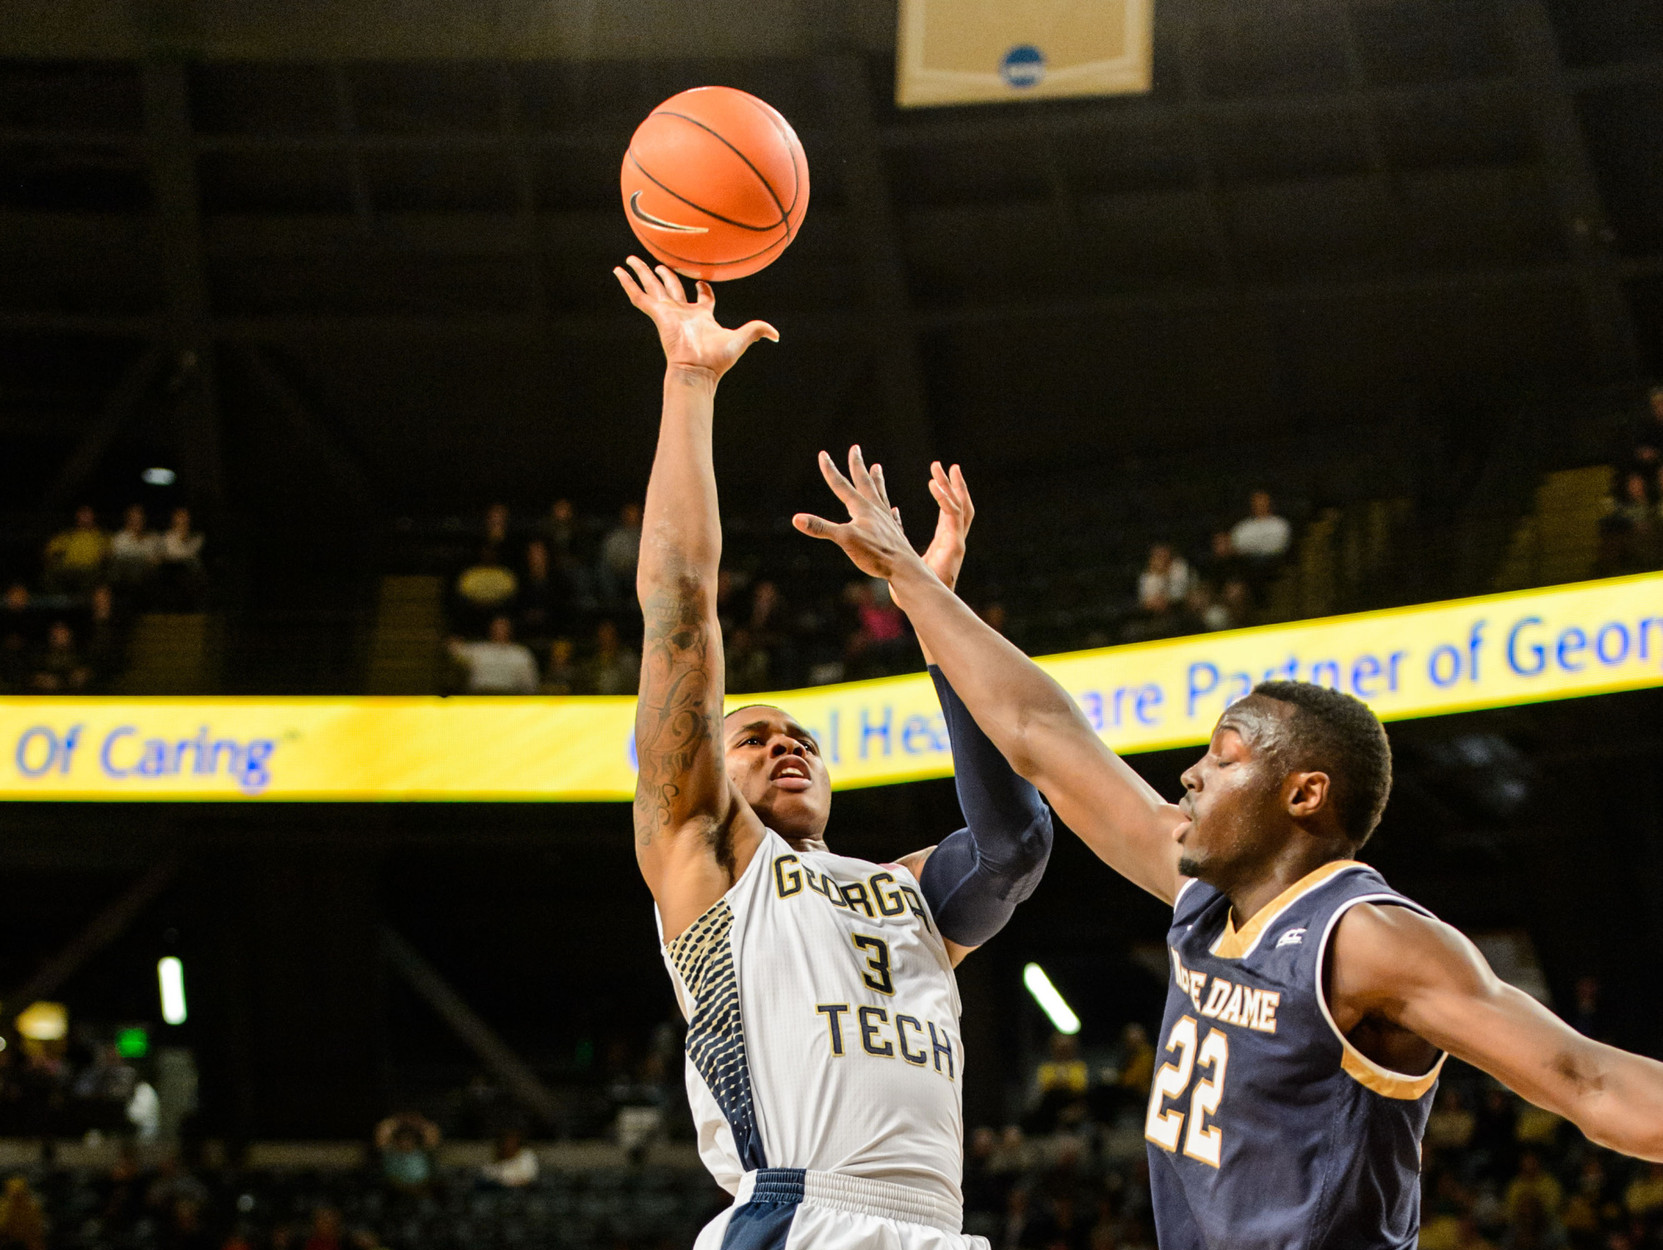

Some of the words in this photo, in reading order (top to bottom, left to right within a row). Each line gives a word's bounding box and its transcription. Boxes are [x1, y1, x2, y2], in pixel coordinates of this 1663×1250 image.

[1428, 618, 1489, 689] of
[1506, 613, 1663, 677] Geor
[15, 724, 84, 778] Of
[100, 724, 275, 795] Caring
[772, 853, 934, 934] GEORGA
[851, 931, 896, 997] 3
[815, 1003, 956, 1082] TECH
[1201, 977, 1281, 1034] DAME
[1144, 1014, 1229, 1169] 22
